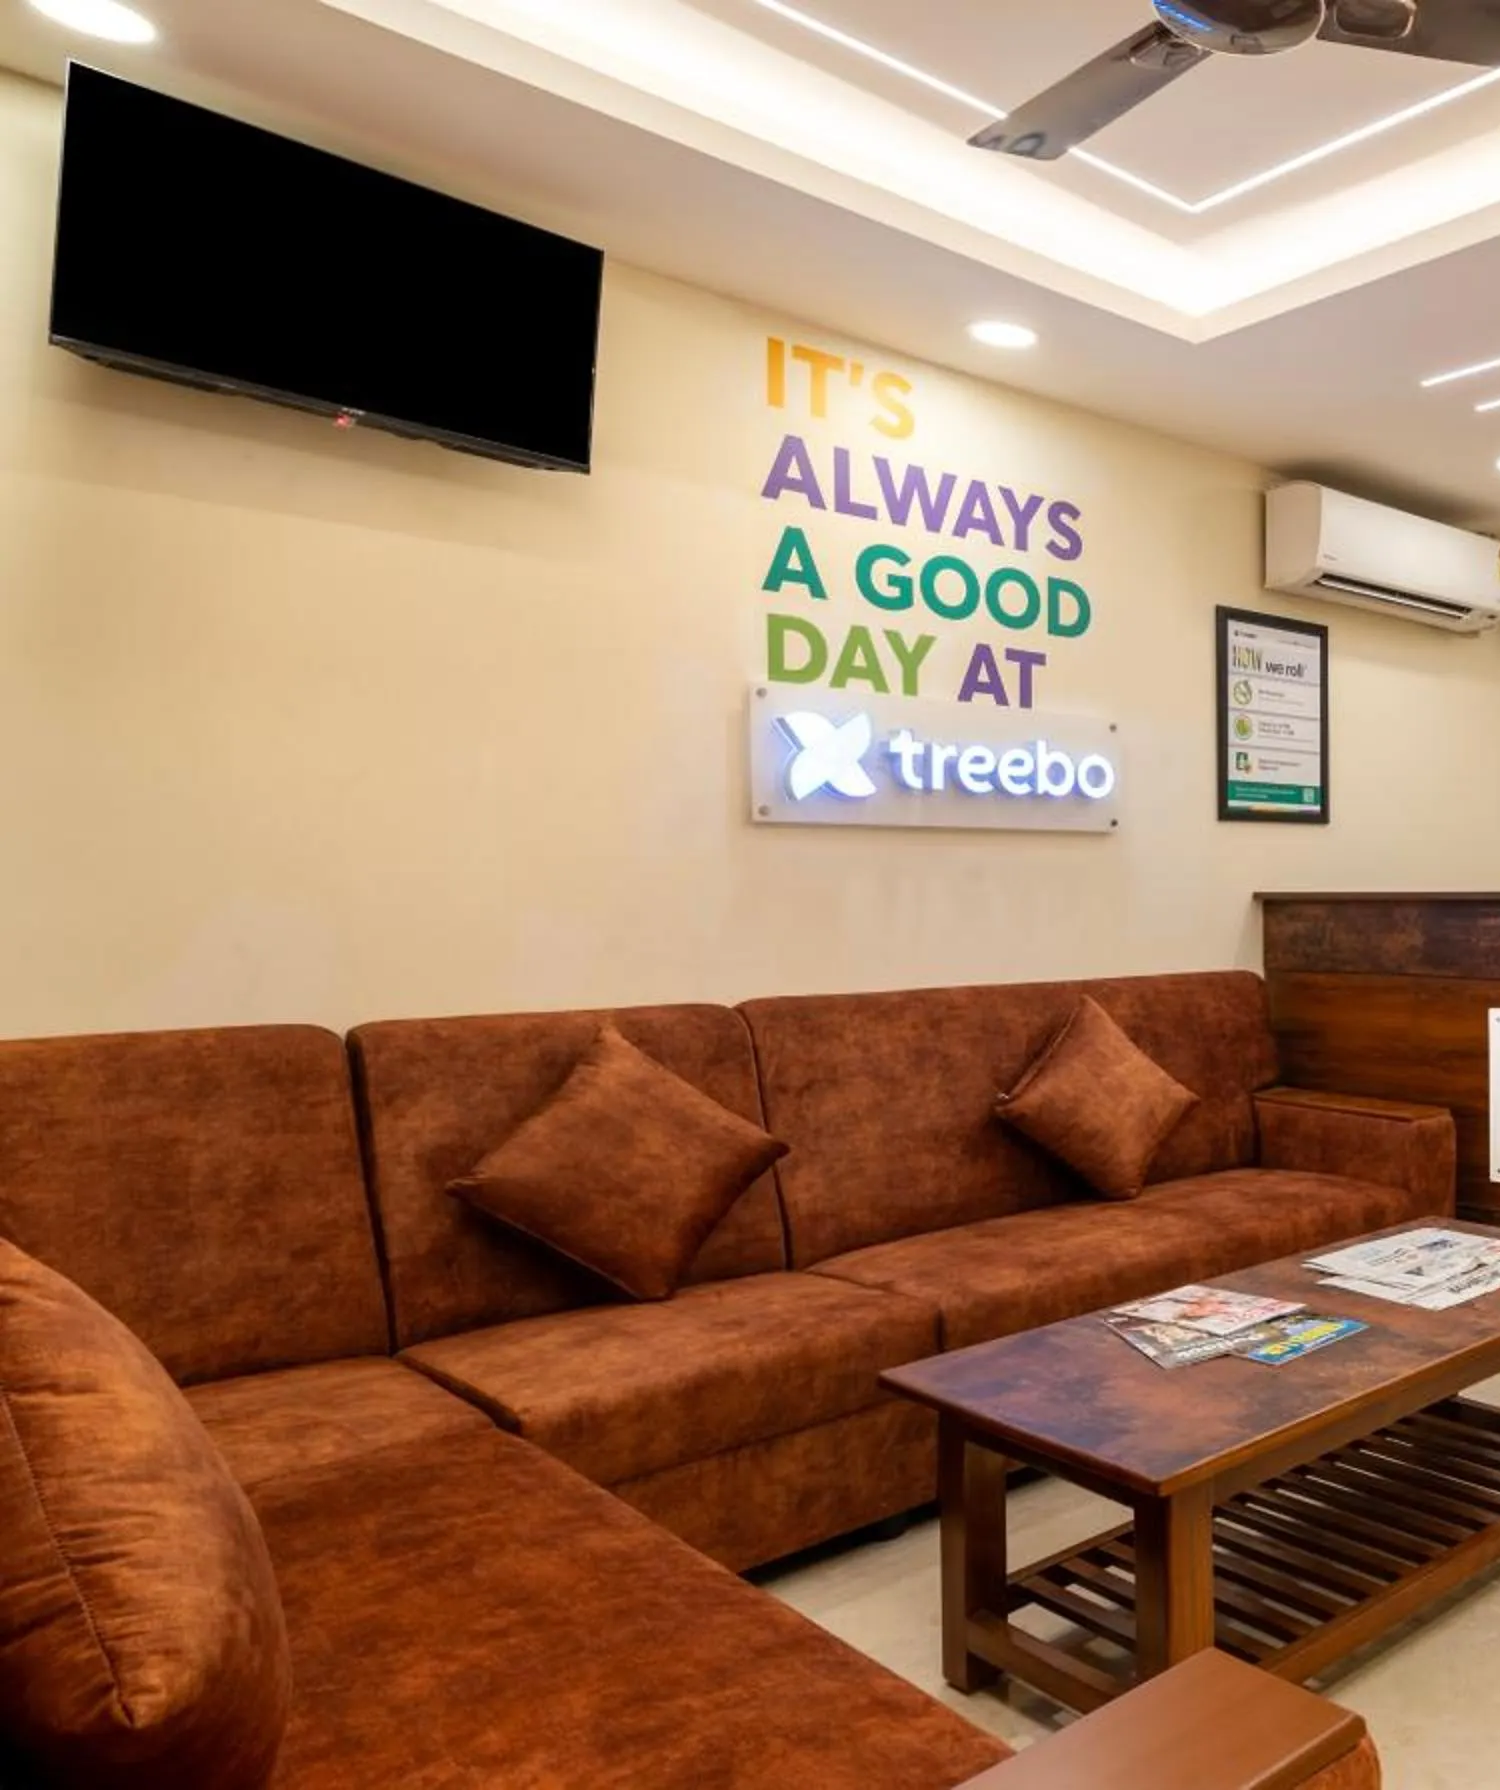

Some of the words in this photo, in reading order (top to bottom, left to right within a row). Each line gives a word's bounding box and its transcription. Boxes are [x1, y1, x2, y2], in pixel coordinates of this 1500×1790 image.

[766, 336, 915, 440] IT'S
[761, 434, 1083, 561] ALWAYS
[762, 525, 828, 600] A
[855, 543, 1091, 638] GOOD
[766, 612, 937, 697] DAY
[957, 643, 1047, 709] AT
[886, 728, 1114, 799] treebo
